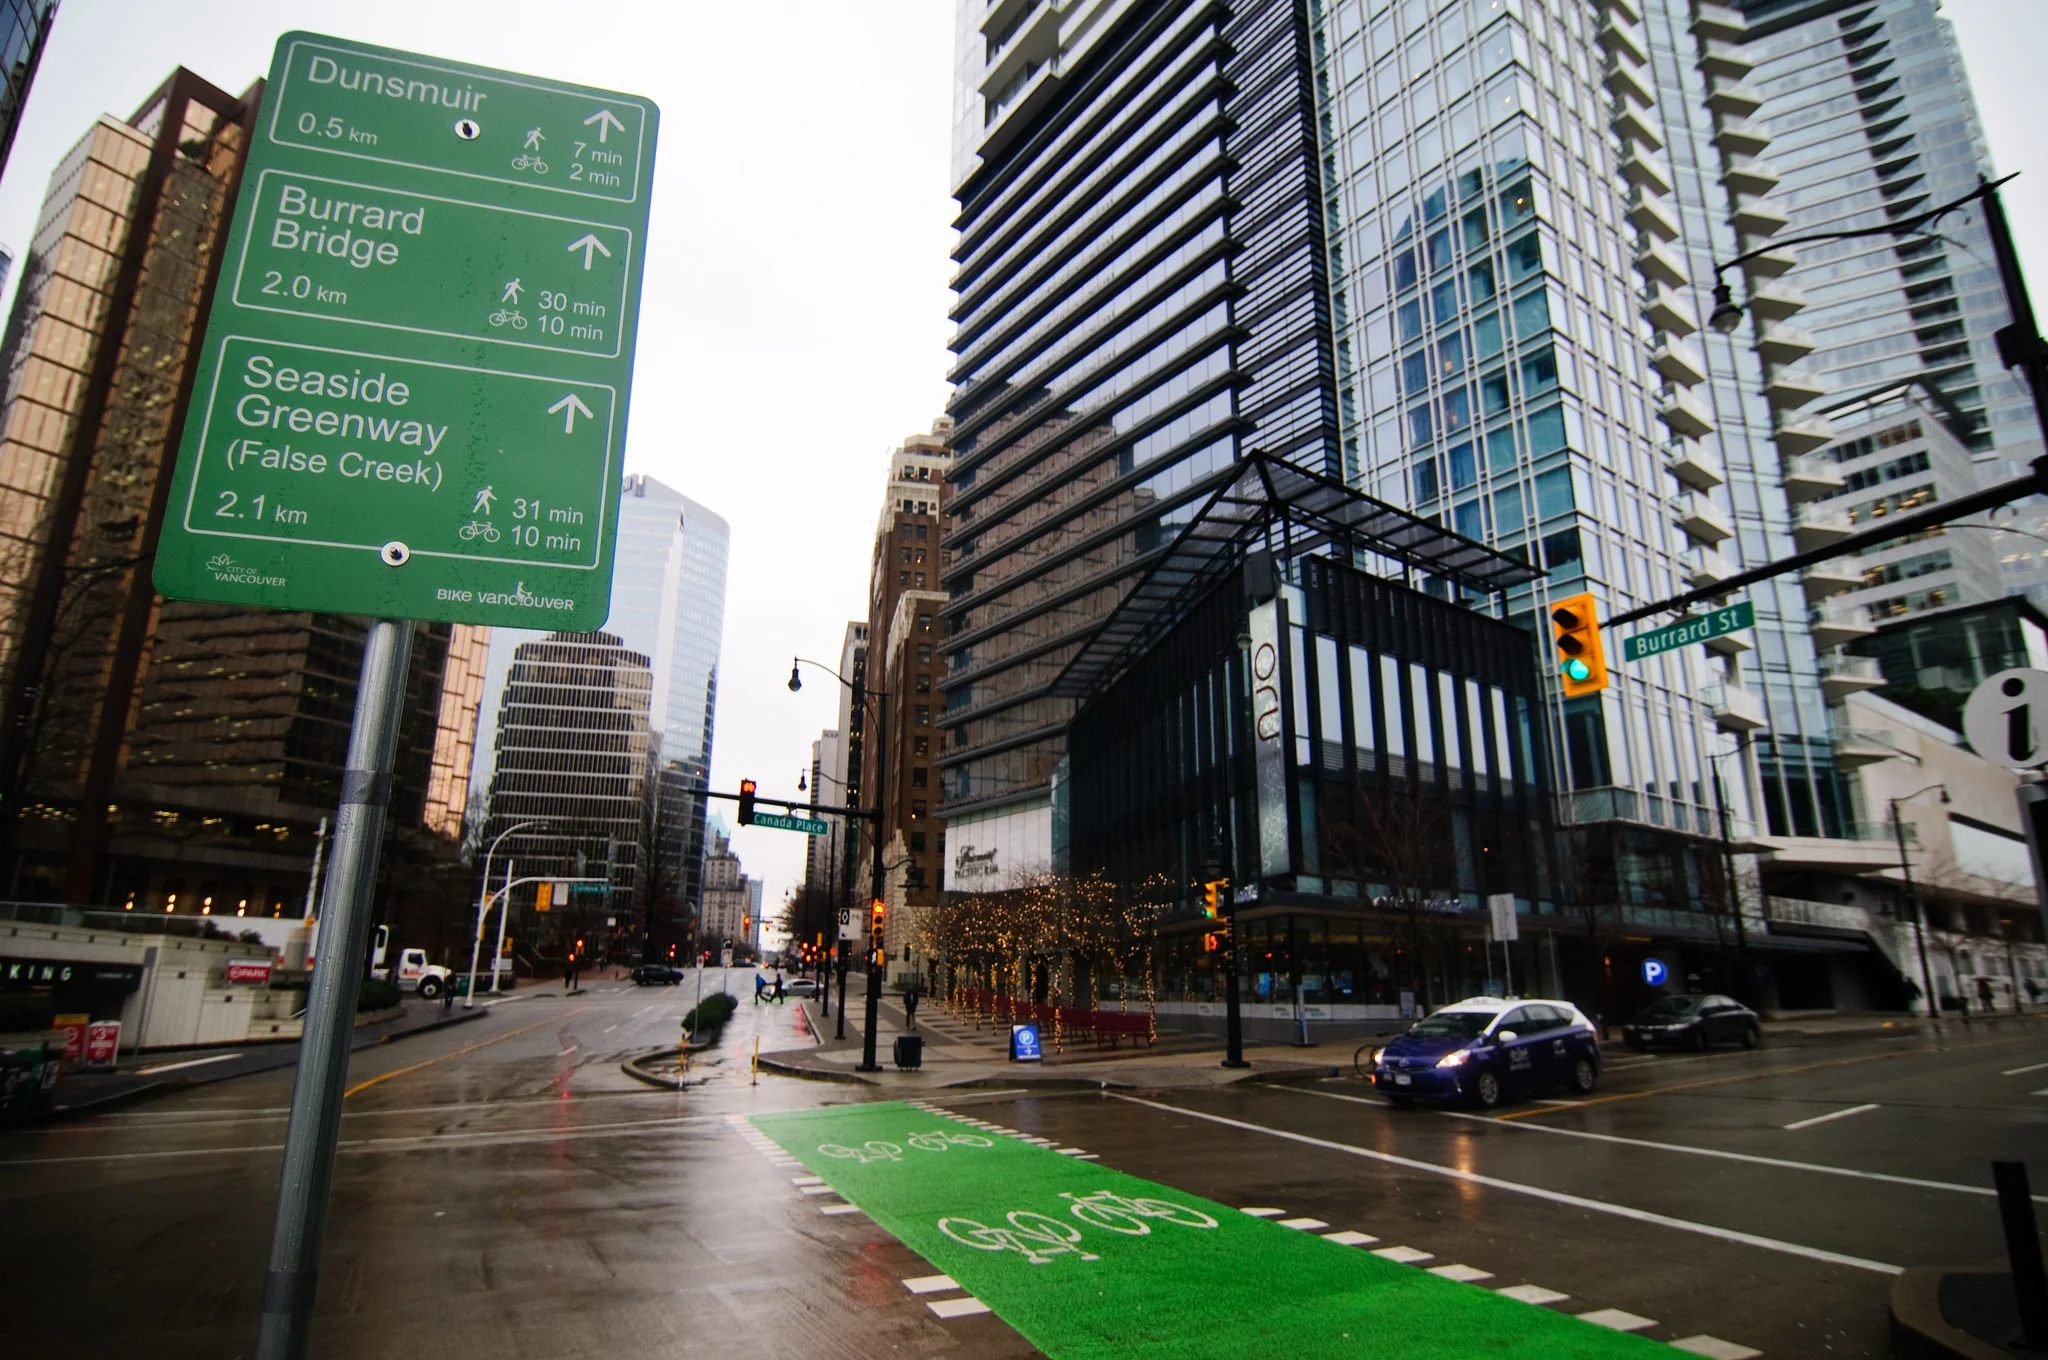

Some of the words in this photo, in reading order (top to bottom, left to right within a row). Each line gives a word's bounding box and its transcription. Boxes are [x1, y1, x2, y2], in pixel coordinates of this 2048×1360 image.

[308, 55, 488, 112] Dunsmuir
[298, 112, 344, 139] 0.5
[349, 127, 378, 146] km
[573, 141, 587, 159] 7
[591, 150, 622, 166] min
[569, 163, 584, 180] 2
[589, 171, 620, 187] min
[278, 185, 425, 236] Burrard
[271, 218, 399, 268] Bridge
[261, 271, 311, 299] 2.0
[316, 285, 347, 304] km
[539, 291, 568, 312] 30
[573, 302, 606, 318] min
[539, 315, 565, 336] 10
[570, 325, 603, 341] min
[243, 355, 410, 406] Seaside
[235, 394, 448, 455] Greenway
[226, 438, 328, 474] (False
[339, 451, 443, 492] Creek)
[215, 490, 266, 520] 2.1
[275, 504, 308, 525] km
[512, 498, 540, 520] 31
[549, 507, 584, 525] min
[512, 525, 539, 547] 10
[546, 536, 581, 551] min
[215, 573, 286, 586] VANCOUVER
[1636, 617, 1710, 655] Burrard
[1718, 609, 1739, 631] St
[754, 813, 792, 828] Canada
[796, 820, 823, 832] Place
[0, 963, 72, 981] KING
[1645, 961, 1662, 982] P
